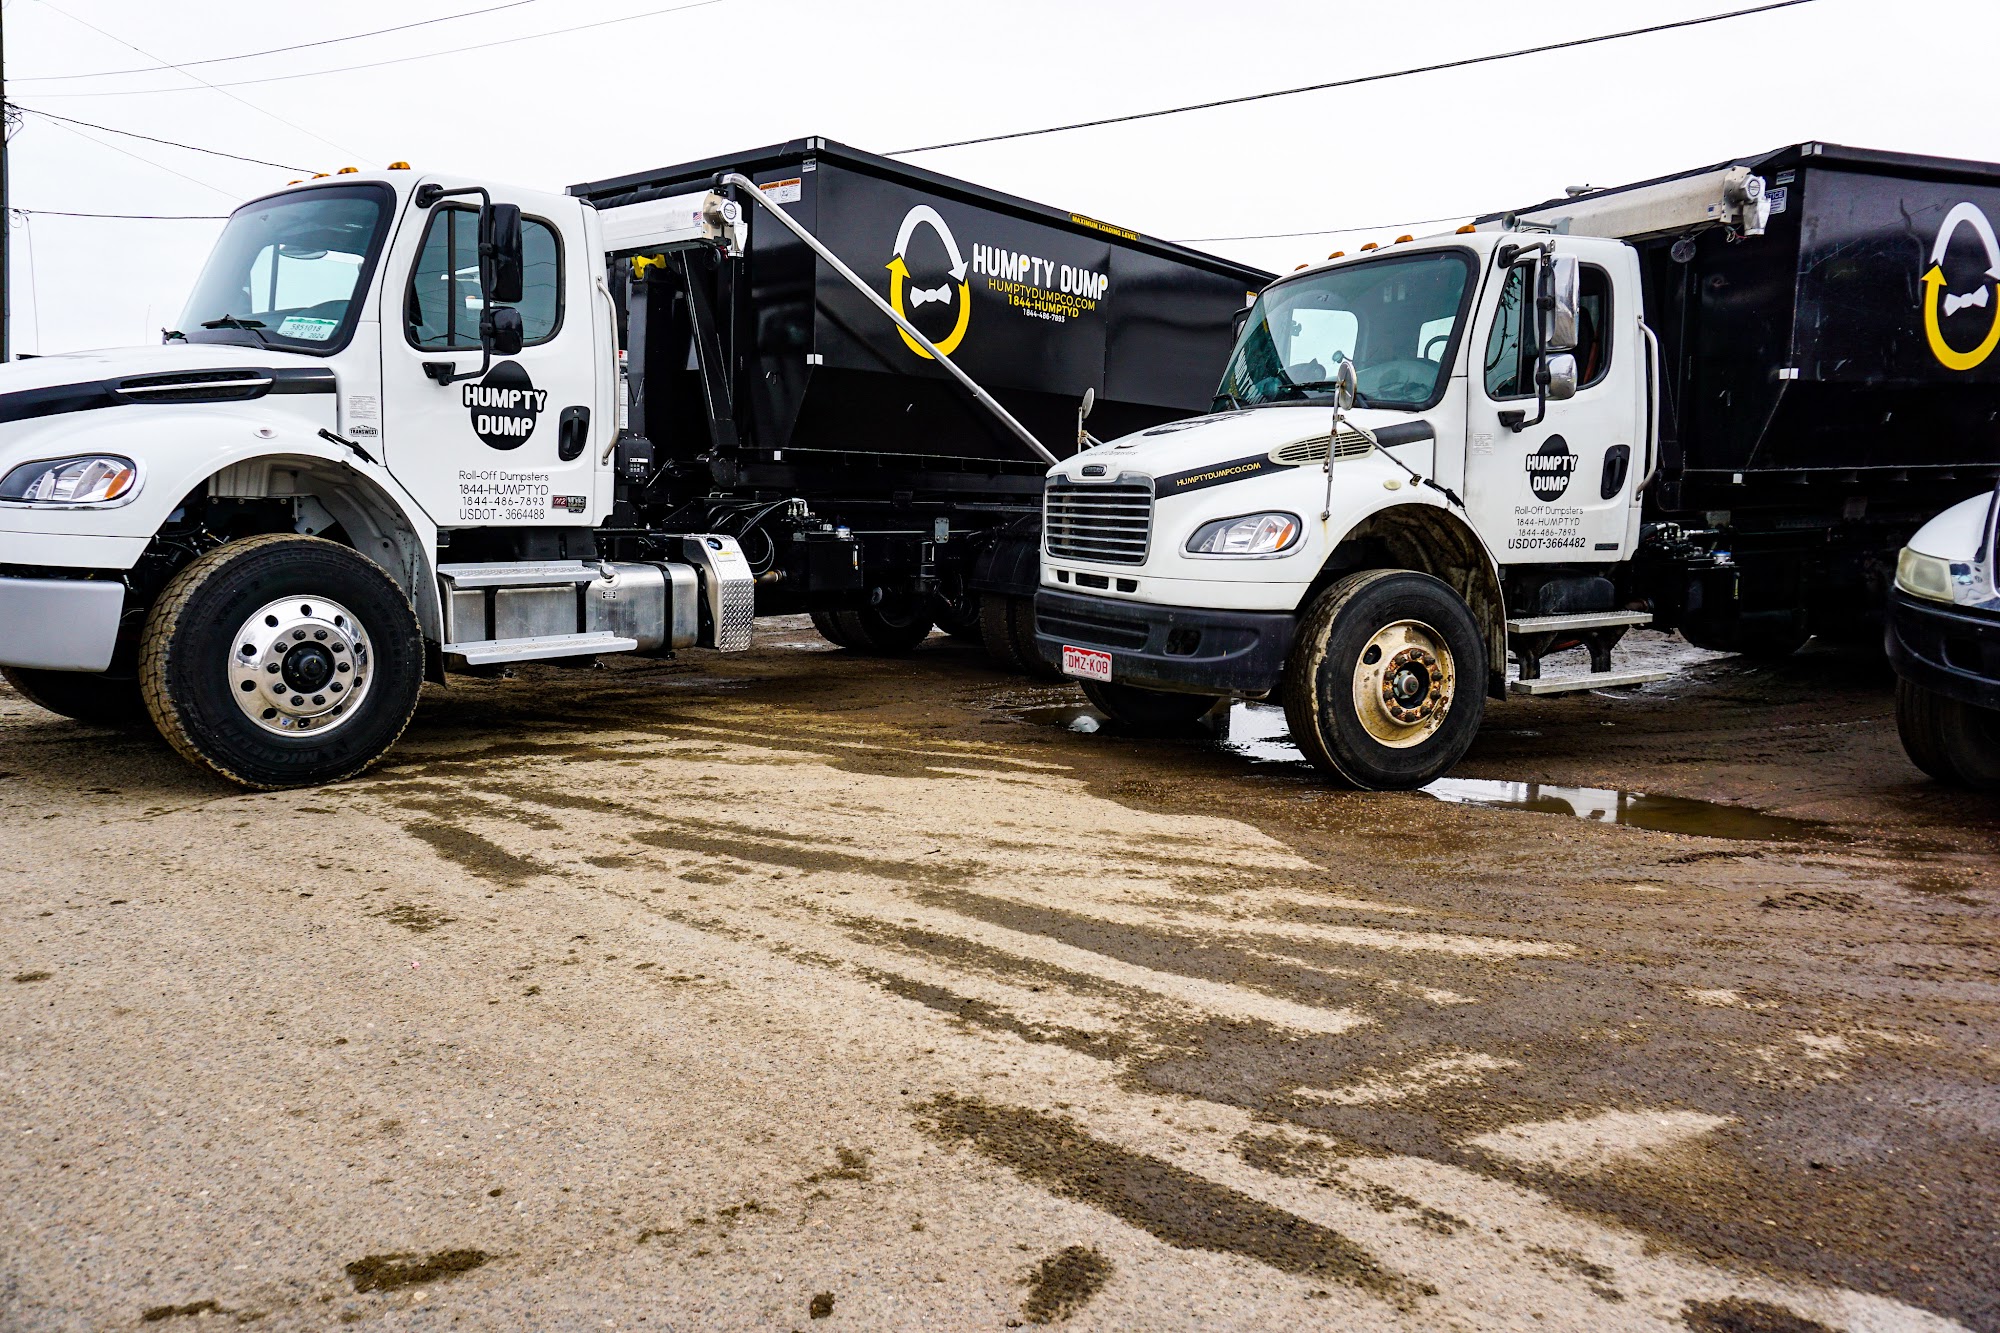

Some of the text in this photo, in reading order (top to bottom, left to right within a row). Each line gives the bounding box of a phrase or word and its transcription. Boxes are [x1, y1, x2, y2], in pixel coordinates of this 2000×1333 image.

[1072, 215, 1137, 241] MAXIMUM LOADING LEVEL
[973, 243, 1109, 300] HUMPTY DUMP
[988, 278, 1096, 312] HUMPTYDUMPCO.COM
[1008, 294, 1079, 318] 1844-HUMPTYD
[1022, 308, 1065, 323] 1844-486-7893
[464, 385, 546, 411] HUMPTY
[477, 414, 533, 437] DUMP
[1526, 455, 1578, 471] HUMPTY
[459, 470, 549, 483] Roll-Off Dumpsters
[1176, 462, 1262, 487] HUMPTYDUMPCO.COM
[459, 484, 549, 496] 1844-HUMPTYD
[1533, 475, 1569, 491] DUMP
[462, 496, 545, 506] 1844-486-7893
[459, 508, 497, 520] USDOT
[505, 508, 545, 520] 3664488
[1514, 506, 1584, 516] Roll-Off Dumpsters
[1516, 517, 1580, 526] 1844-HUMPTYD
[1518, 528, 1577, 537] 1844-486-7893
[1508, 537, 1586, 550] USDOT-3664482
